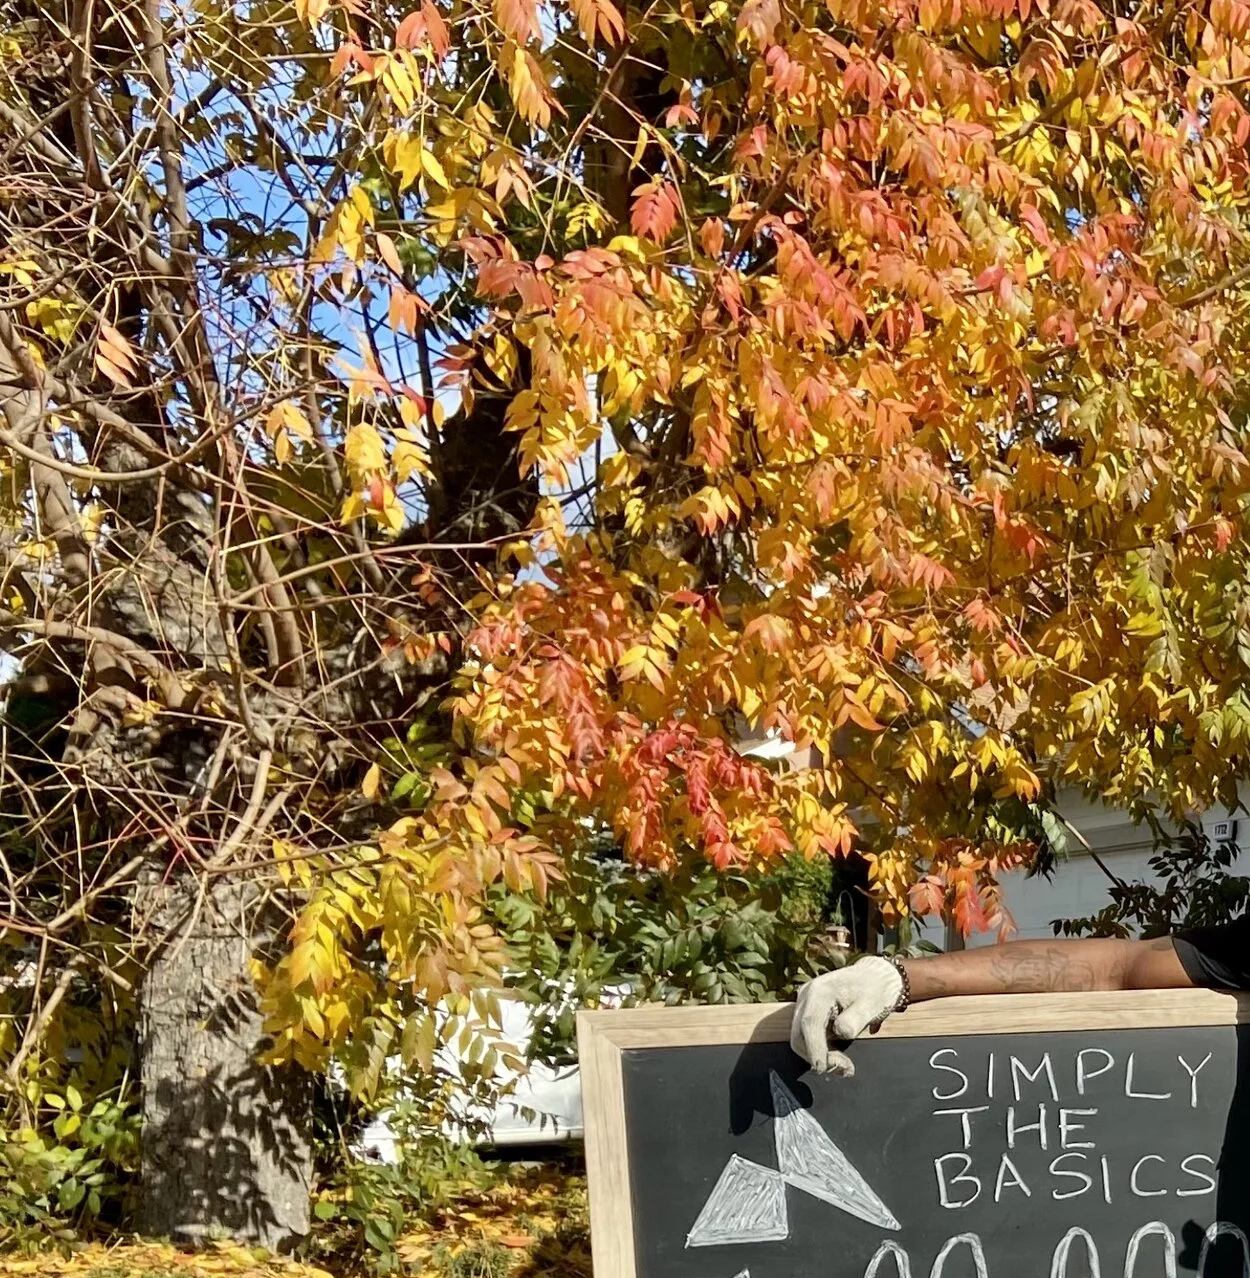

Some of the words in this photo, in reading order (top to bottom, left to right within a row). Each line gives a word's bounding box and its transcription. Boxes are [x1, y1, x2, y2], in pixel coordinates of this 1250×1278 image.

[929, 1048, 1213, 1107] SIMPLY
[931, 1104, 1099, 1150] THE
[934, 1152, 1218, 1208] BASICS
